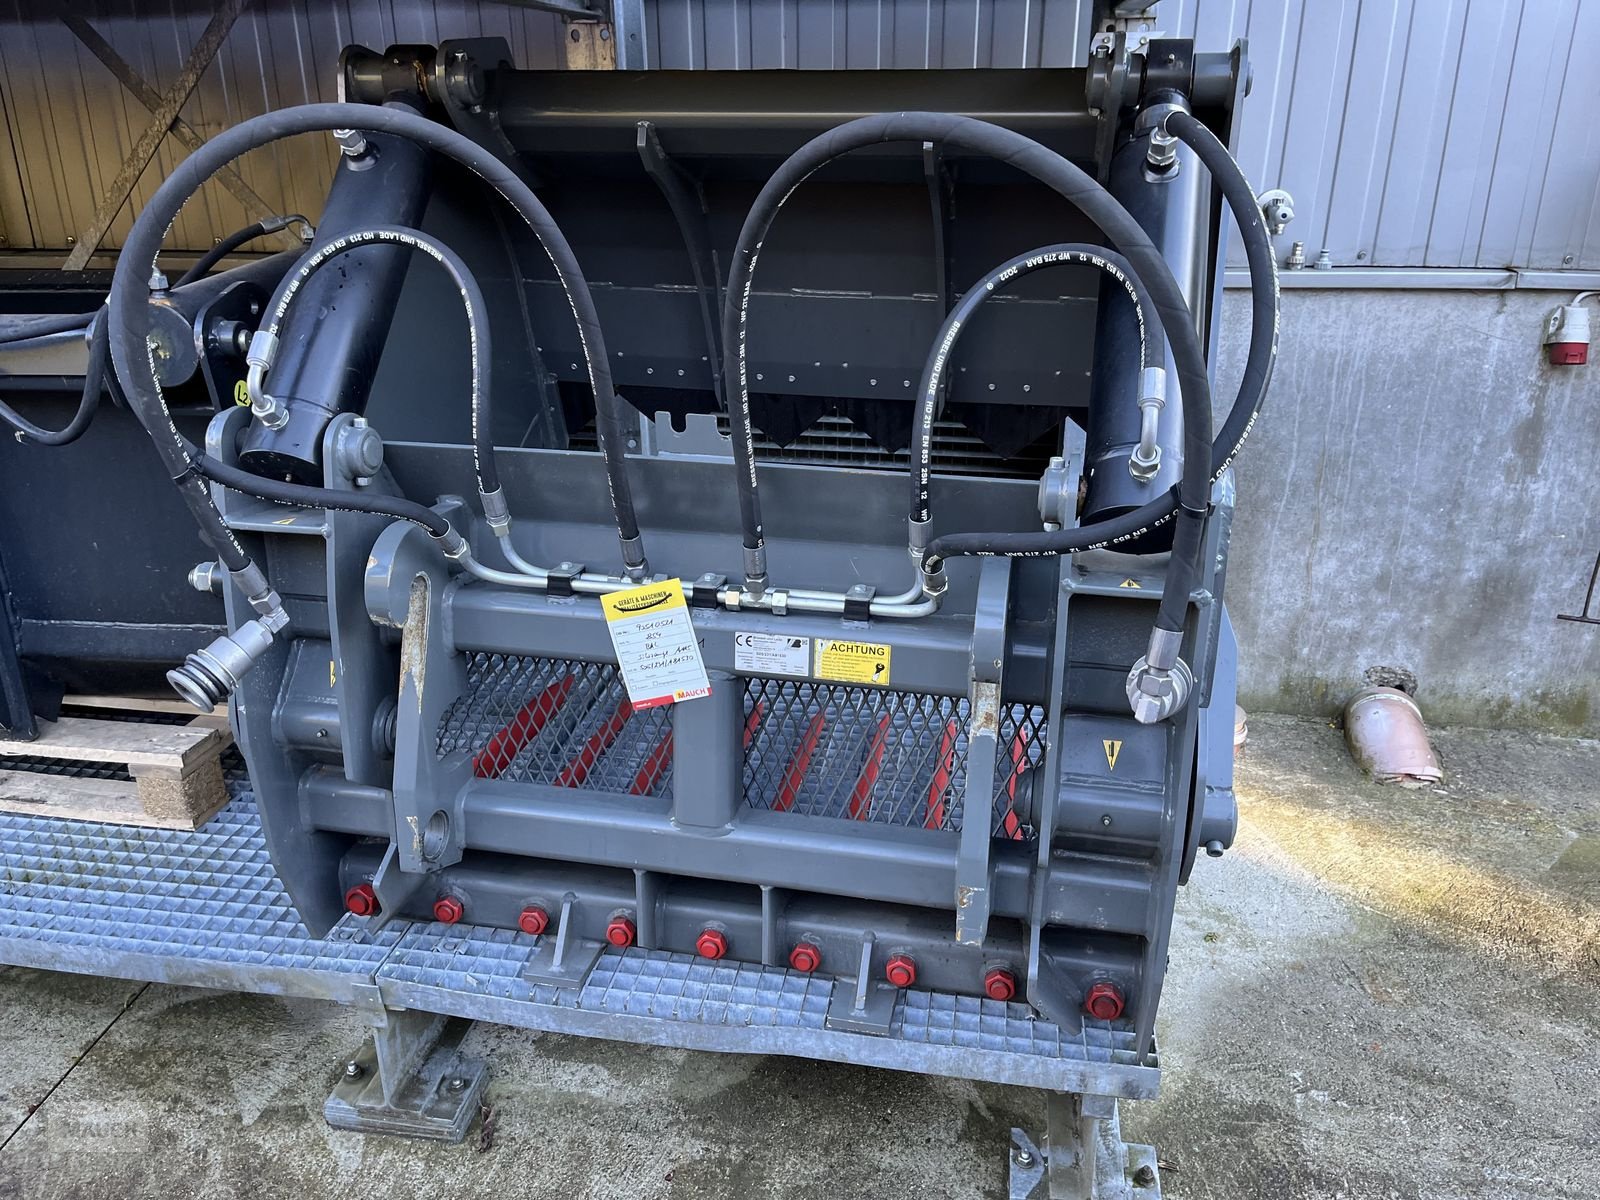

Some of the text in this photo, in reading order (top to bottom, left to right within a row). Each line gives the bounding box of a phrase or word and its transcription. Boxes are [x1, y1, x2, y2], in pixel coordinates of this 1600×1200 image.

[379, 231, 399, 241] LADE
[1025, 256, 1043, 268] BAR
[1043, 253, 1057, 263] 275
[1058, 252, 1071, 261] WP
[999, 265, 1018, 281] 2Q22
[940, 321, 961, 354] BRESSEL
[934, 355, 945, 372] UND
[928, 373, 939, 396] LADE
[237, 384, 248, 406] L2
[925, 401, 933, 413] HD
[923, 415, 932, 429] 213
[922, 435, 929, 447] EN
[1216, 457, 1232, 477] UND
[920, 468, 928, 485] 2SN
[920, 491, 928, 500] 12
[830, 643, 885, 656] ACHTUNG
[677, 688, 706, 699] MAUCH
